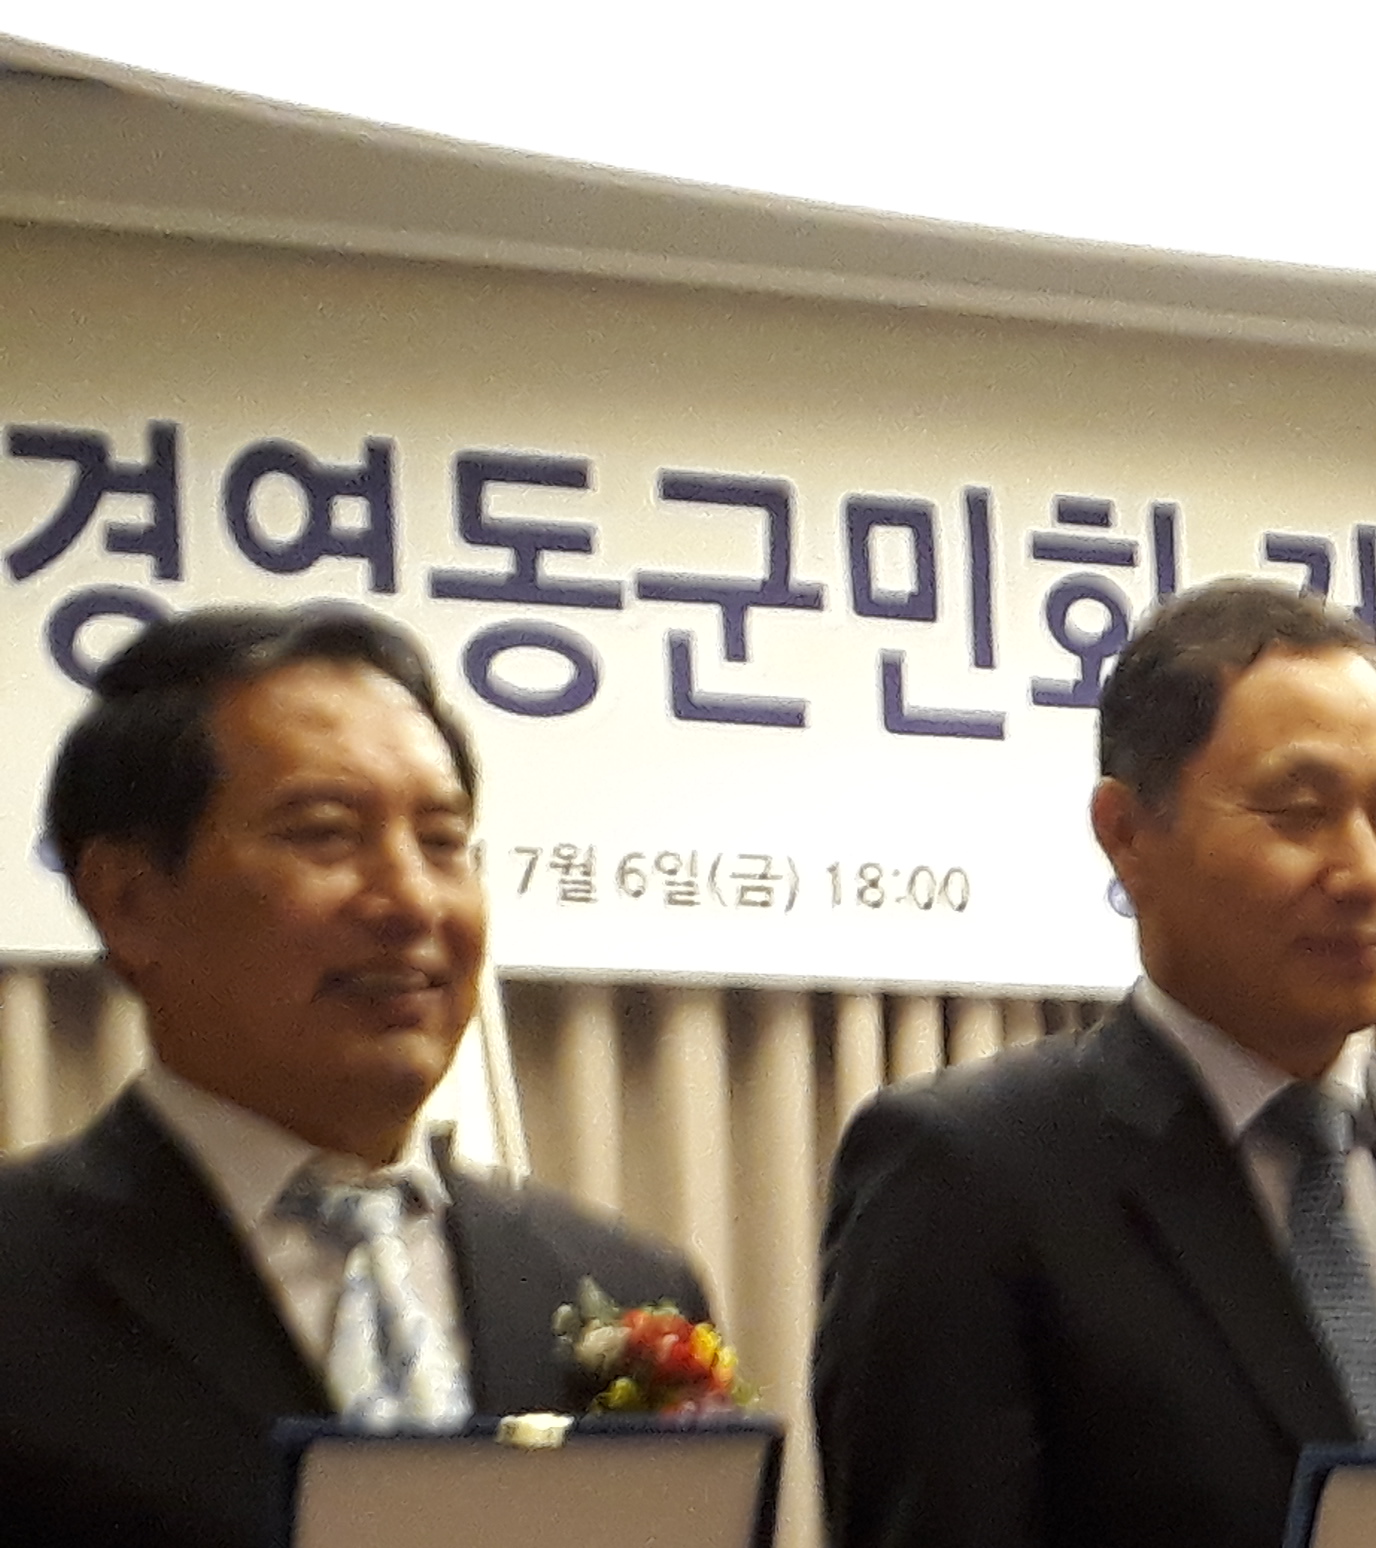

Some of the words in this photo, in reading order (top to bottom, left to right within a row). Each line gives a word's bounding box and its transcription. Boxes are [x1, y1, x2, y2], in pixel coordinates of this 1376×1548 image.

[511, 842, 598, 906] 7월
[615, 849, 800, 914] 6일(금)
[825, 860, 971, 913] 18:00
